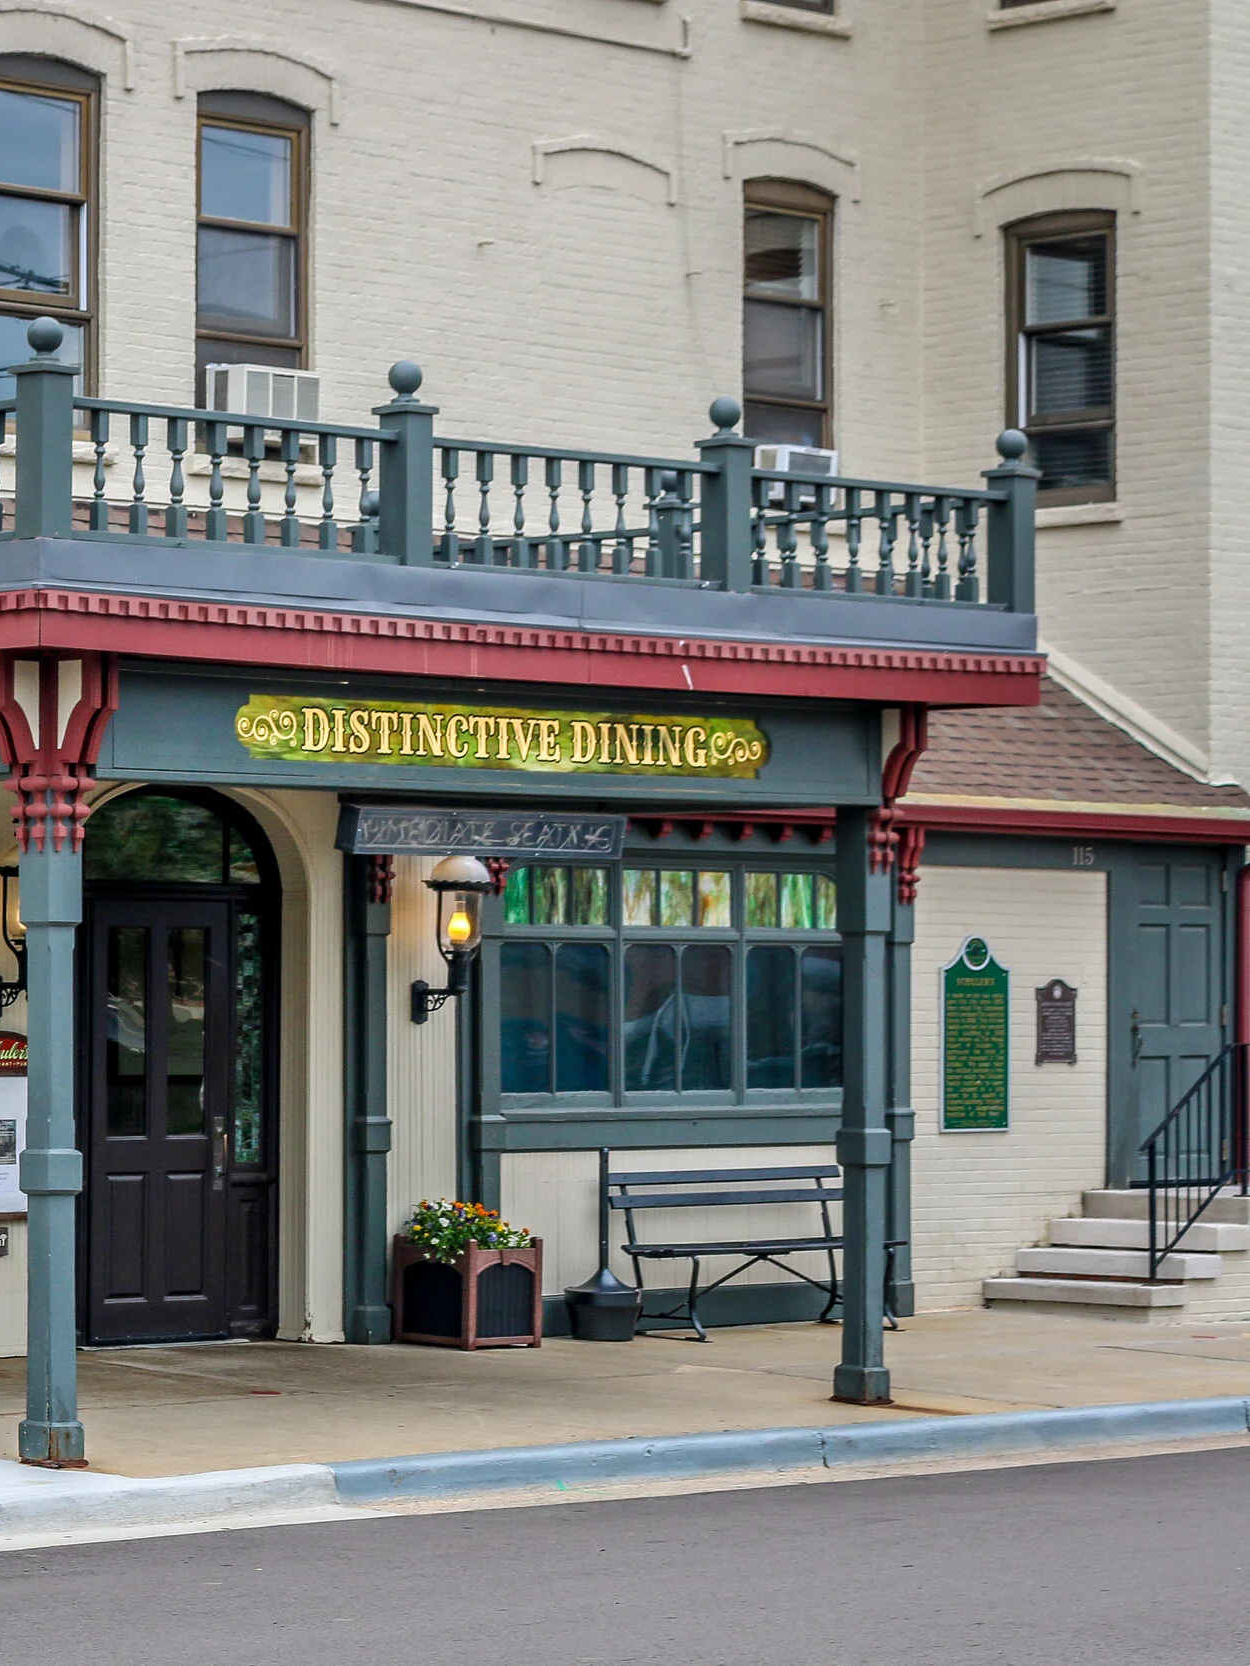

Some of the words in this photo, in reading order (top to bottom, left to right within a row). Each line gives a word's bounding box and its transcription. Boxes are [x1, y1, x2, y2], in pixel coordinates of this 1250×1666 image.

[301, 707, 562, 763] DISTINCTIVE
[570, 720, 710, 768] DINING
[1073, 846, 1095, 866] 115
